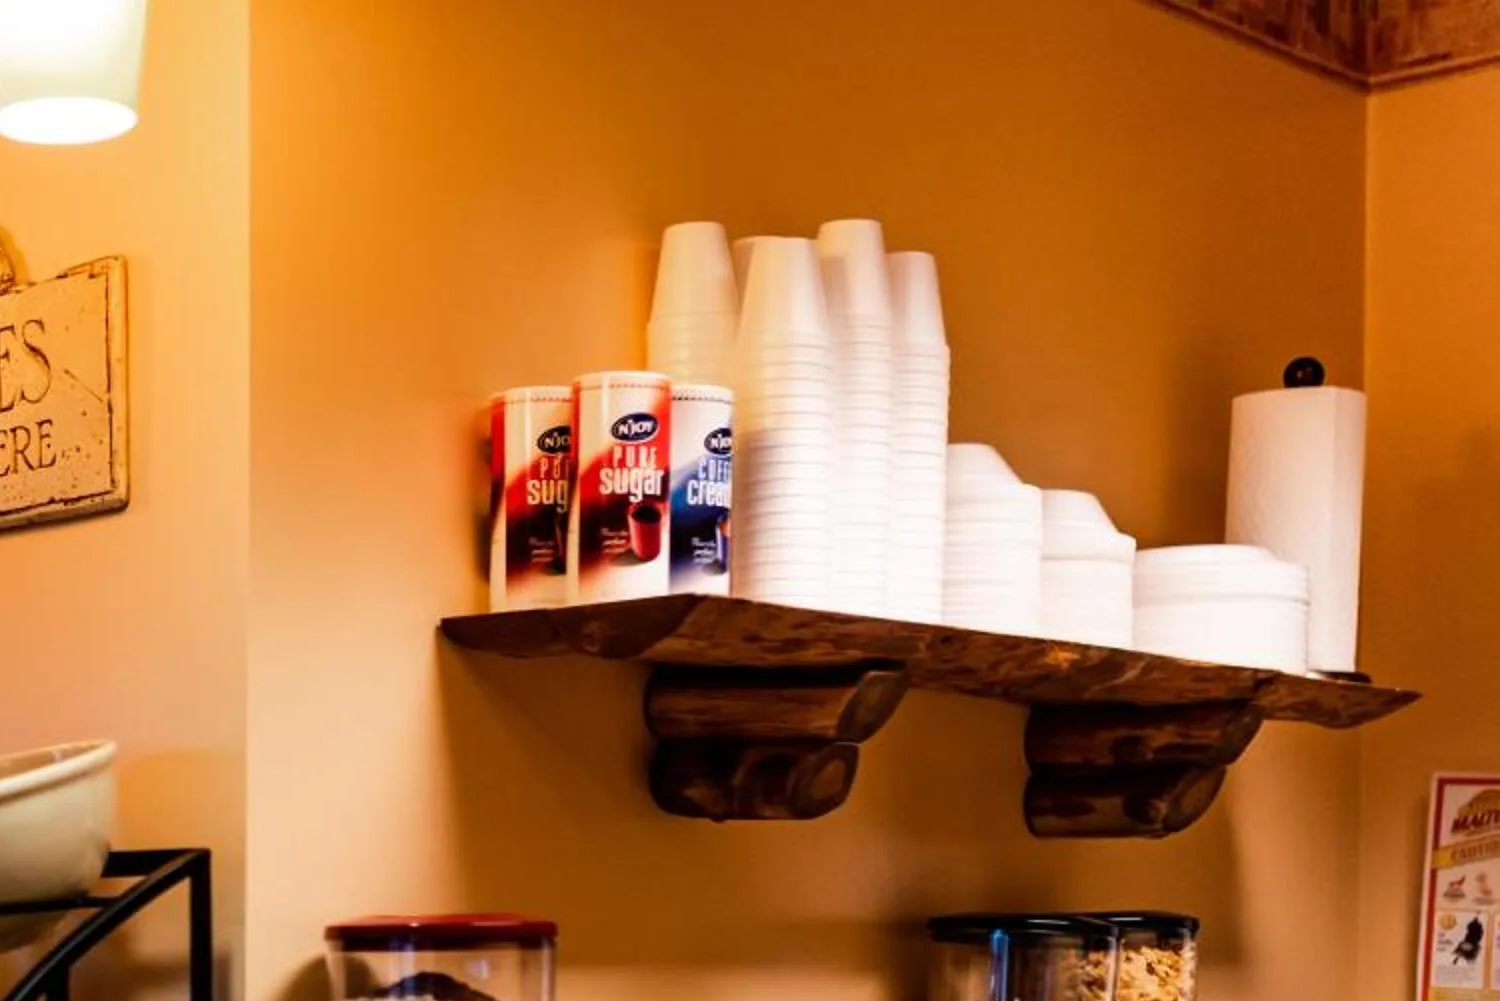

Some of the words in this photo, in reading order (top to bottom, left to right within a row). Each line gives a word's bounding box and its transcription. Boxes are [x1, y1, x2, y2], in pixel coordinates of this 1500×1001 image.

[540, 456, 569, 479] PU
[698, 458, 732, 481] COFF
[526, 479, 568, 514] sug
[599, 467, 664, 503] sugar
[687, 479, 732, 507] crea
